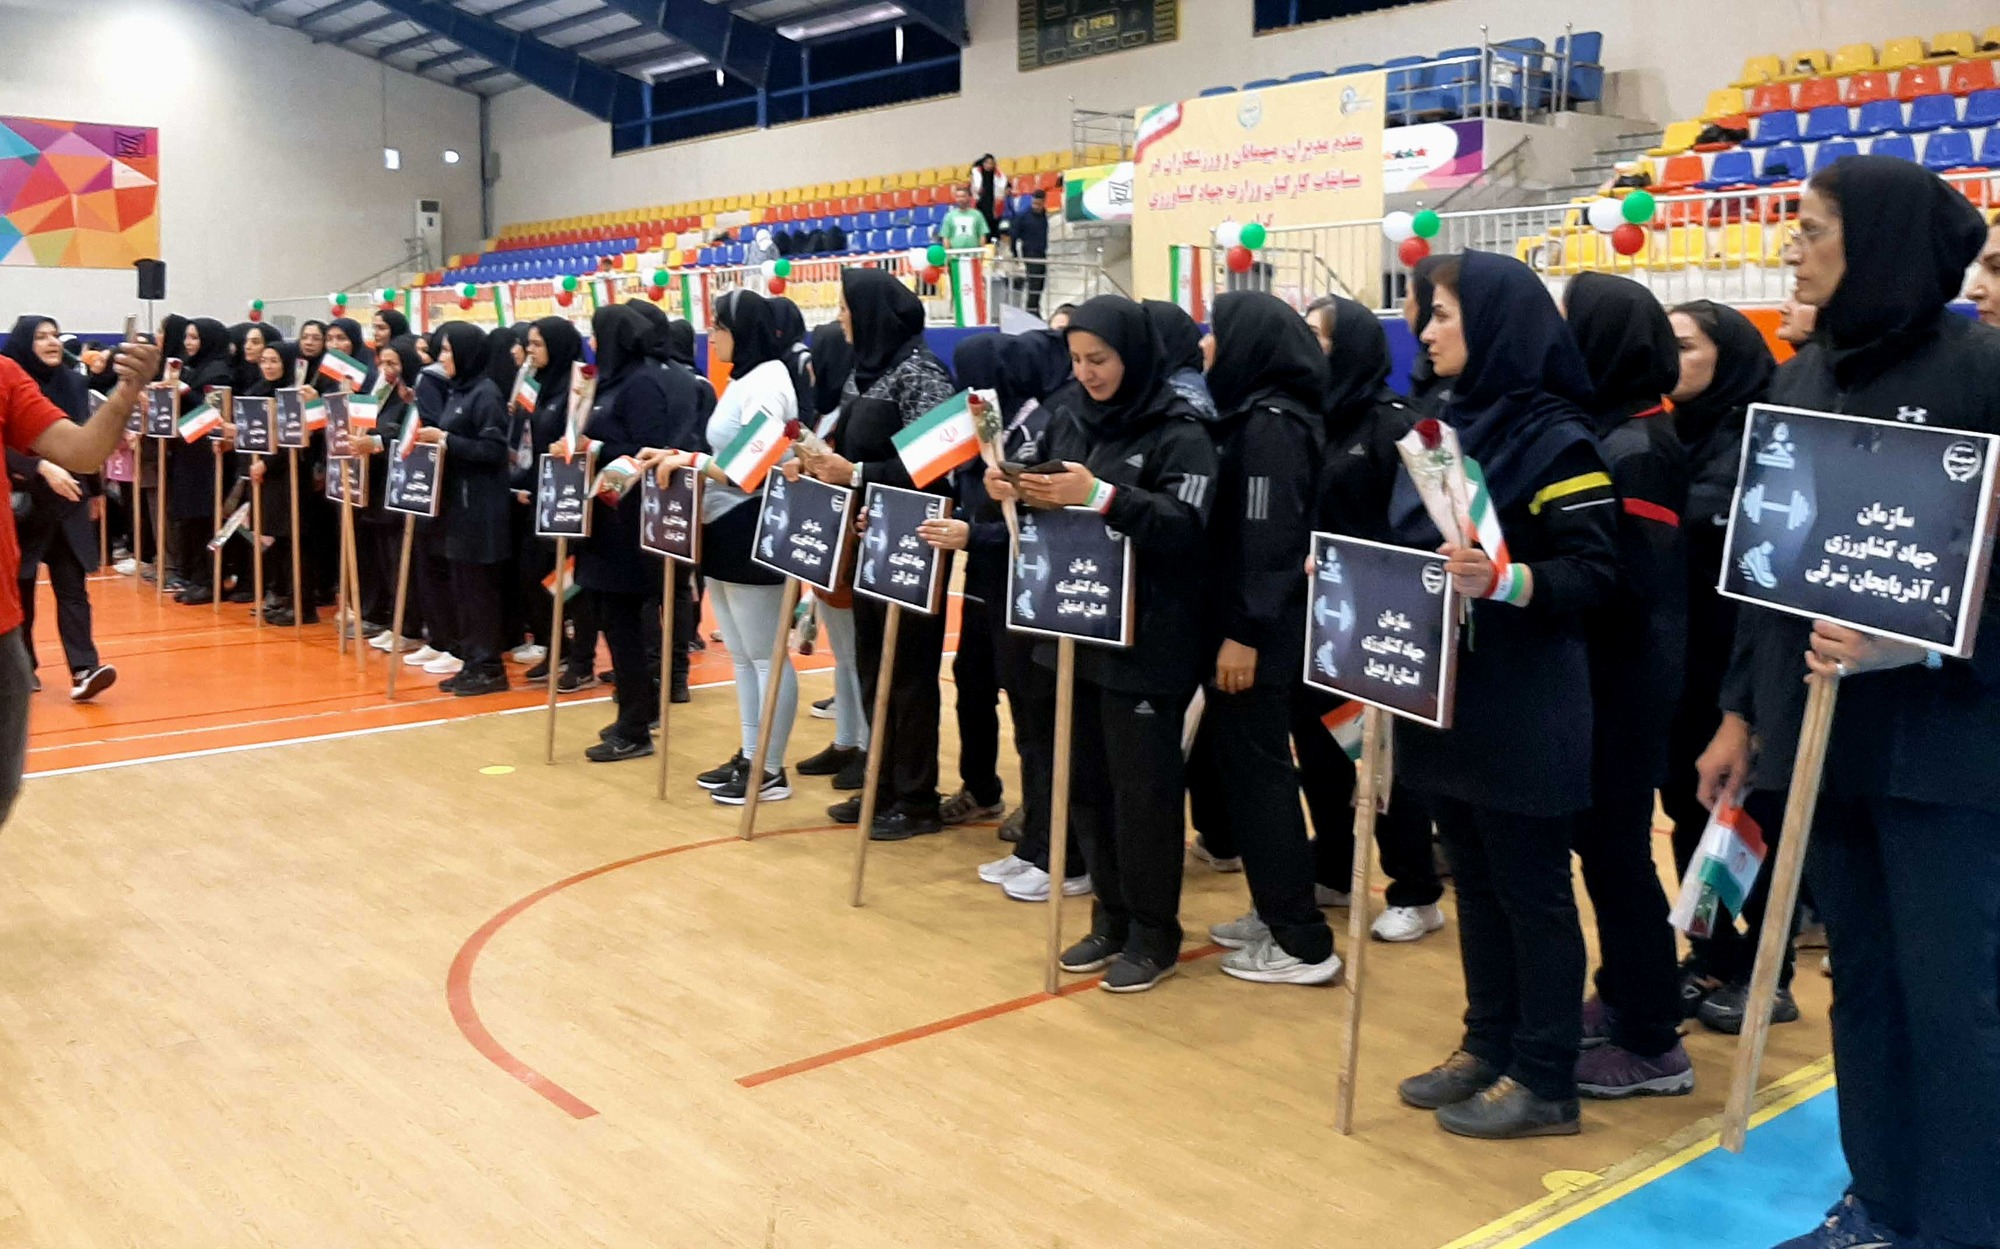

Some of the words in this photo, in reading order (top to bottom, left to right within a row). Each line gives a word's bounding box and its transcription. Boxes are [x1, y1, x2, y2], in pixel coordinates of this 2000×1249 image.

[1857, 502, 1915, 531] سازمان
[1824, 534, 1898, 560] کشاورزی
[1897, 543, 1938, 572] جهاد
[1068, 557, 1098, 575] سازمان
[1804, 558, 1850, 587] شرقی
[1055, 579, 1091, 595] کشاورزی
[1090, 581, 1110, 598] جهاد
[1849, 569, 1934, 603] آذربایجان
[1377, 609, 1411, 632] سازمان
[1361, 635, 1403, 655] کشاورزی
[1402, 642, 1426, 665] جهاد
